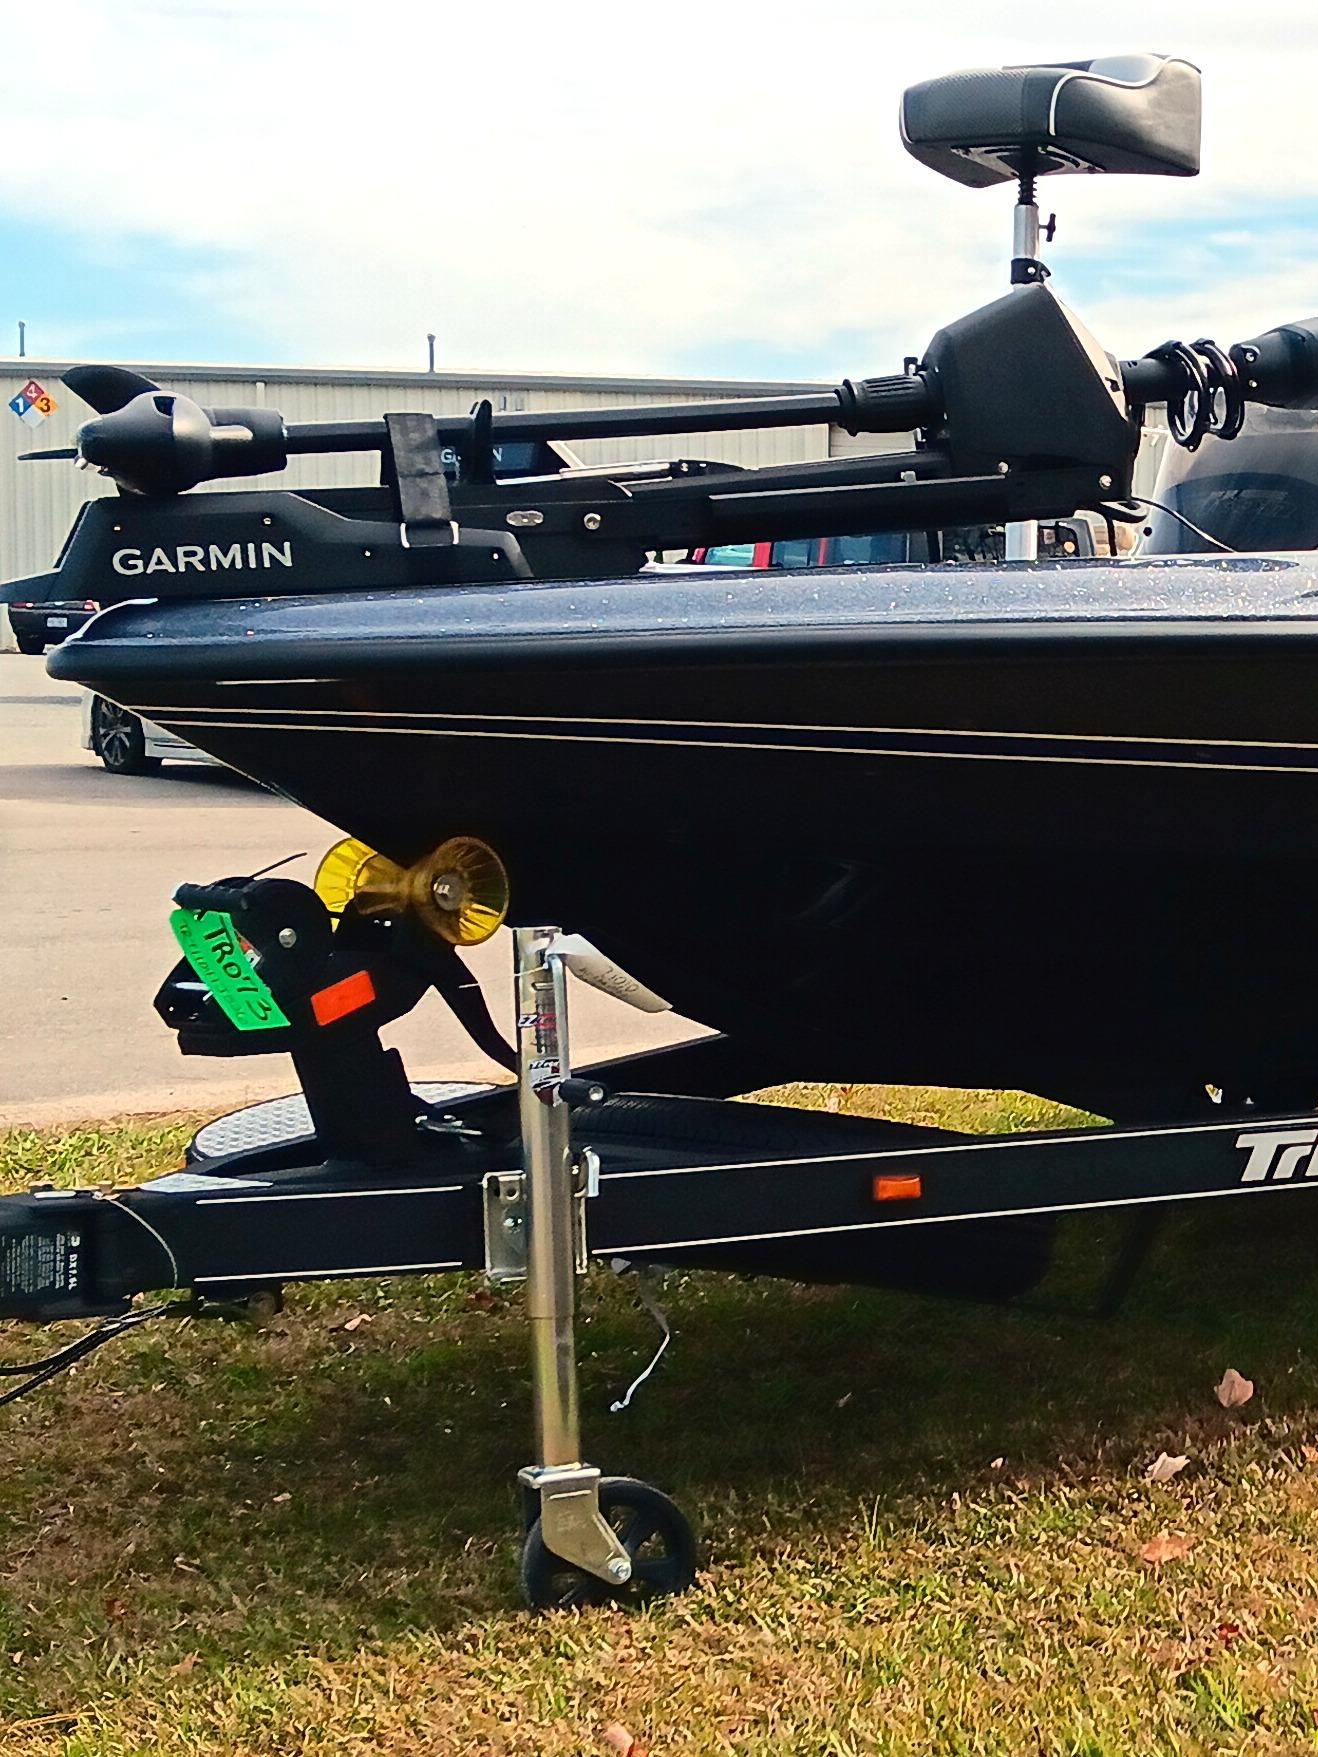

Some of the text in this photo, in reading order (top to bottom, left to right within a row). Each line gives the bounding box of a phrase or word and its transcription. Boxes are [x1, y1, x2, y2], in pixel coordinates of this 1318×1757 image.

[26, 383, 38, 398] 4
[15, 397, 51, 413] 1 3
[112, 541, 293, 576] GARMIN
